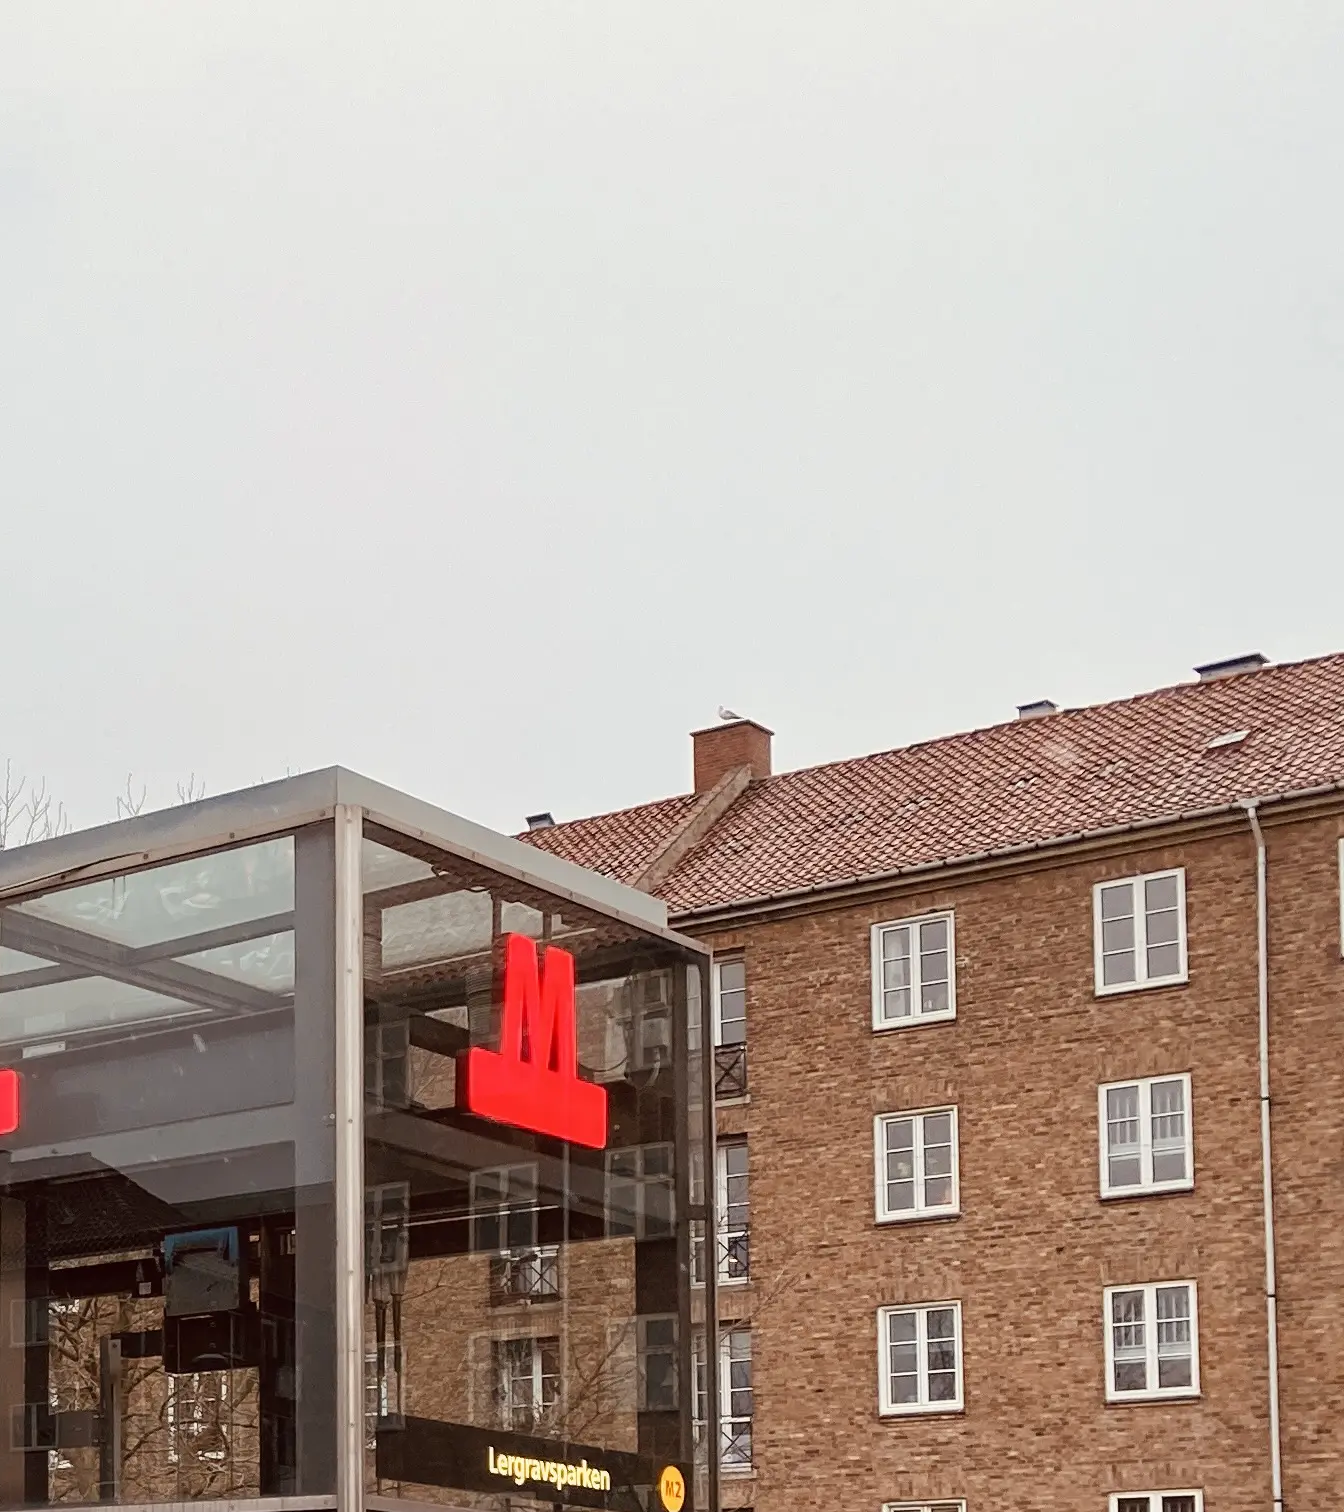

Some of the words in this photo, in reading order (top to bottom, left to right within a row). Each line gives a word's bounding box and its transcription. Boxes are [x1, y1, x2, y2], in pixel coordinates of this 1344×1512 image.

[469, 932, 609, 1150] M
[488, 1446, 611, 1492] Lergravsparken
[665, 1479, 682, 1499] M2
